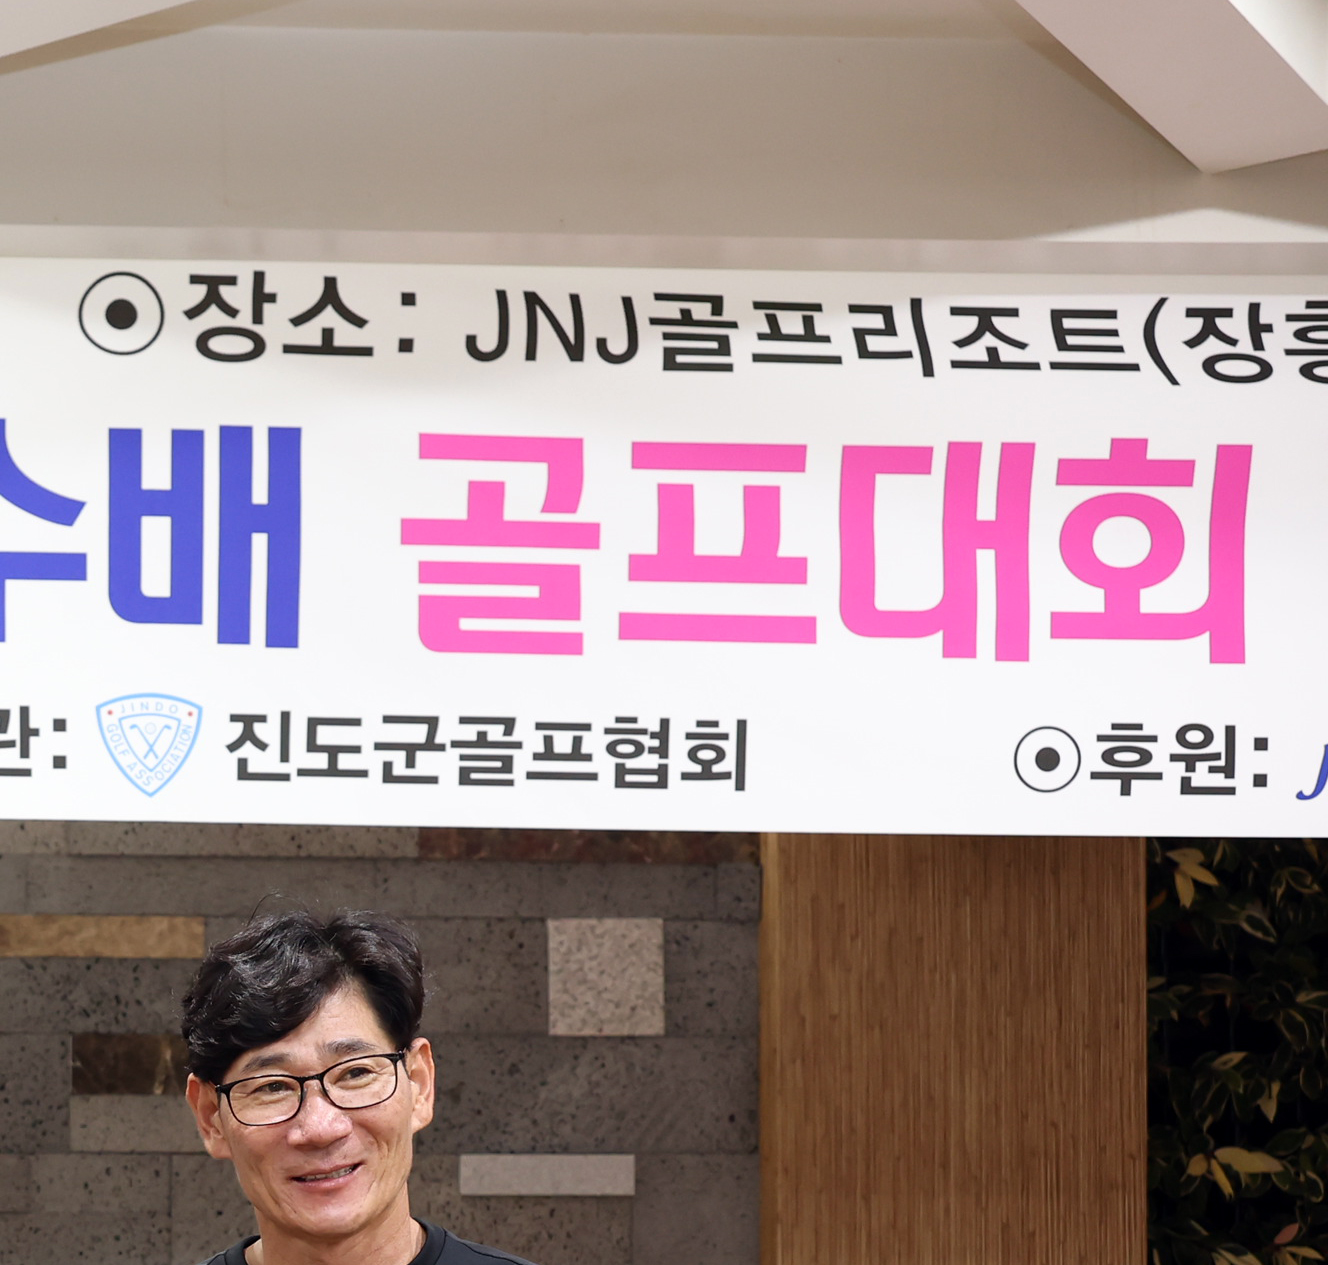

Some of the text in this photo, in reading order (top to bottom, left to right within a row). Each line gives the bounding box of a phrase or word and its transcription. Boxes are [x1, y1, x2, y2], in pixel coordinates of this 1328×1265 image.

[182, 269, 417, 363] 장소:
[400, 432, 1254, 665] 골프대회
[106, 723, 130, 757] GOLF
[120, 701, 179, 714] JINDO
[225, 710, 748, 792] 진도군골프협회
[1089, 722, 1269, 797] 후원:
